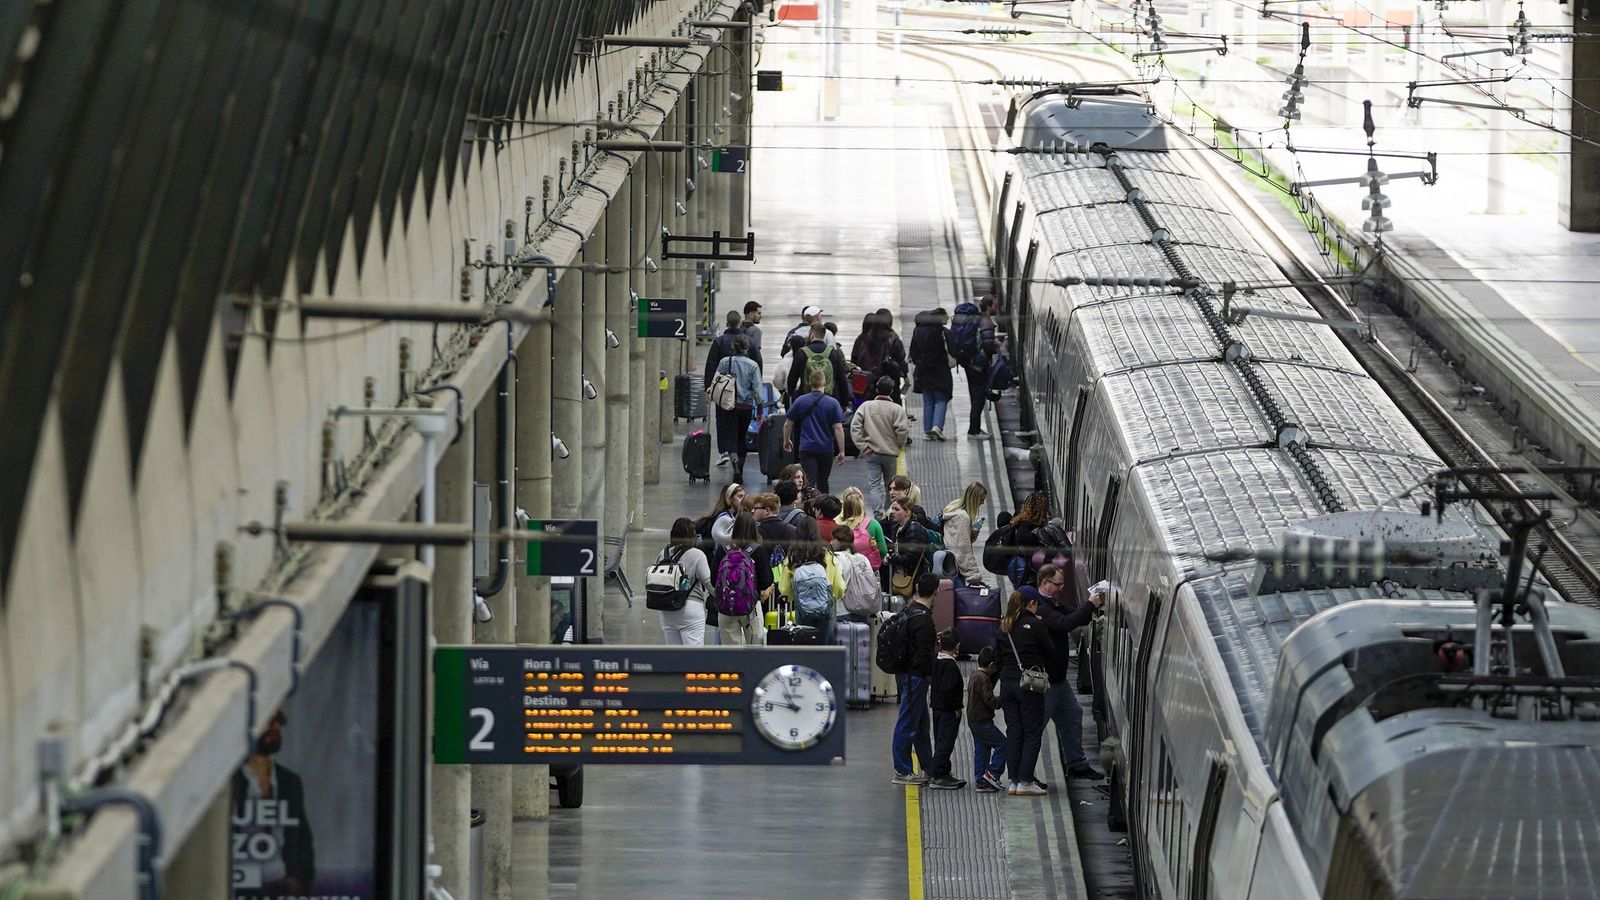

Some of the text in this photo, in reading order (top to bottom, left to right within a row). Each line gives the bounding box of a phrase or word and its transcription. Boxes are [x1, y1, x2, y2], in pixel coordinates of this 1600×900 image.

[737, 160, 745, 172] 2
[674, 318, 685, 336] 2
[580, 548, 594, 573] 2
[523, 659, 581, 670] Hora TIME
[592, 659, 619, 670] Tren
[789, 677, 802, 687] 12
[523, 695, 568, 706] Destino
[764, 702, 774, 712] 9
[816, 702, 824, 712] 3
[469, 706, 495, 751] 2
[790, 727, 799, 737] 6
